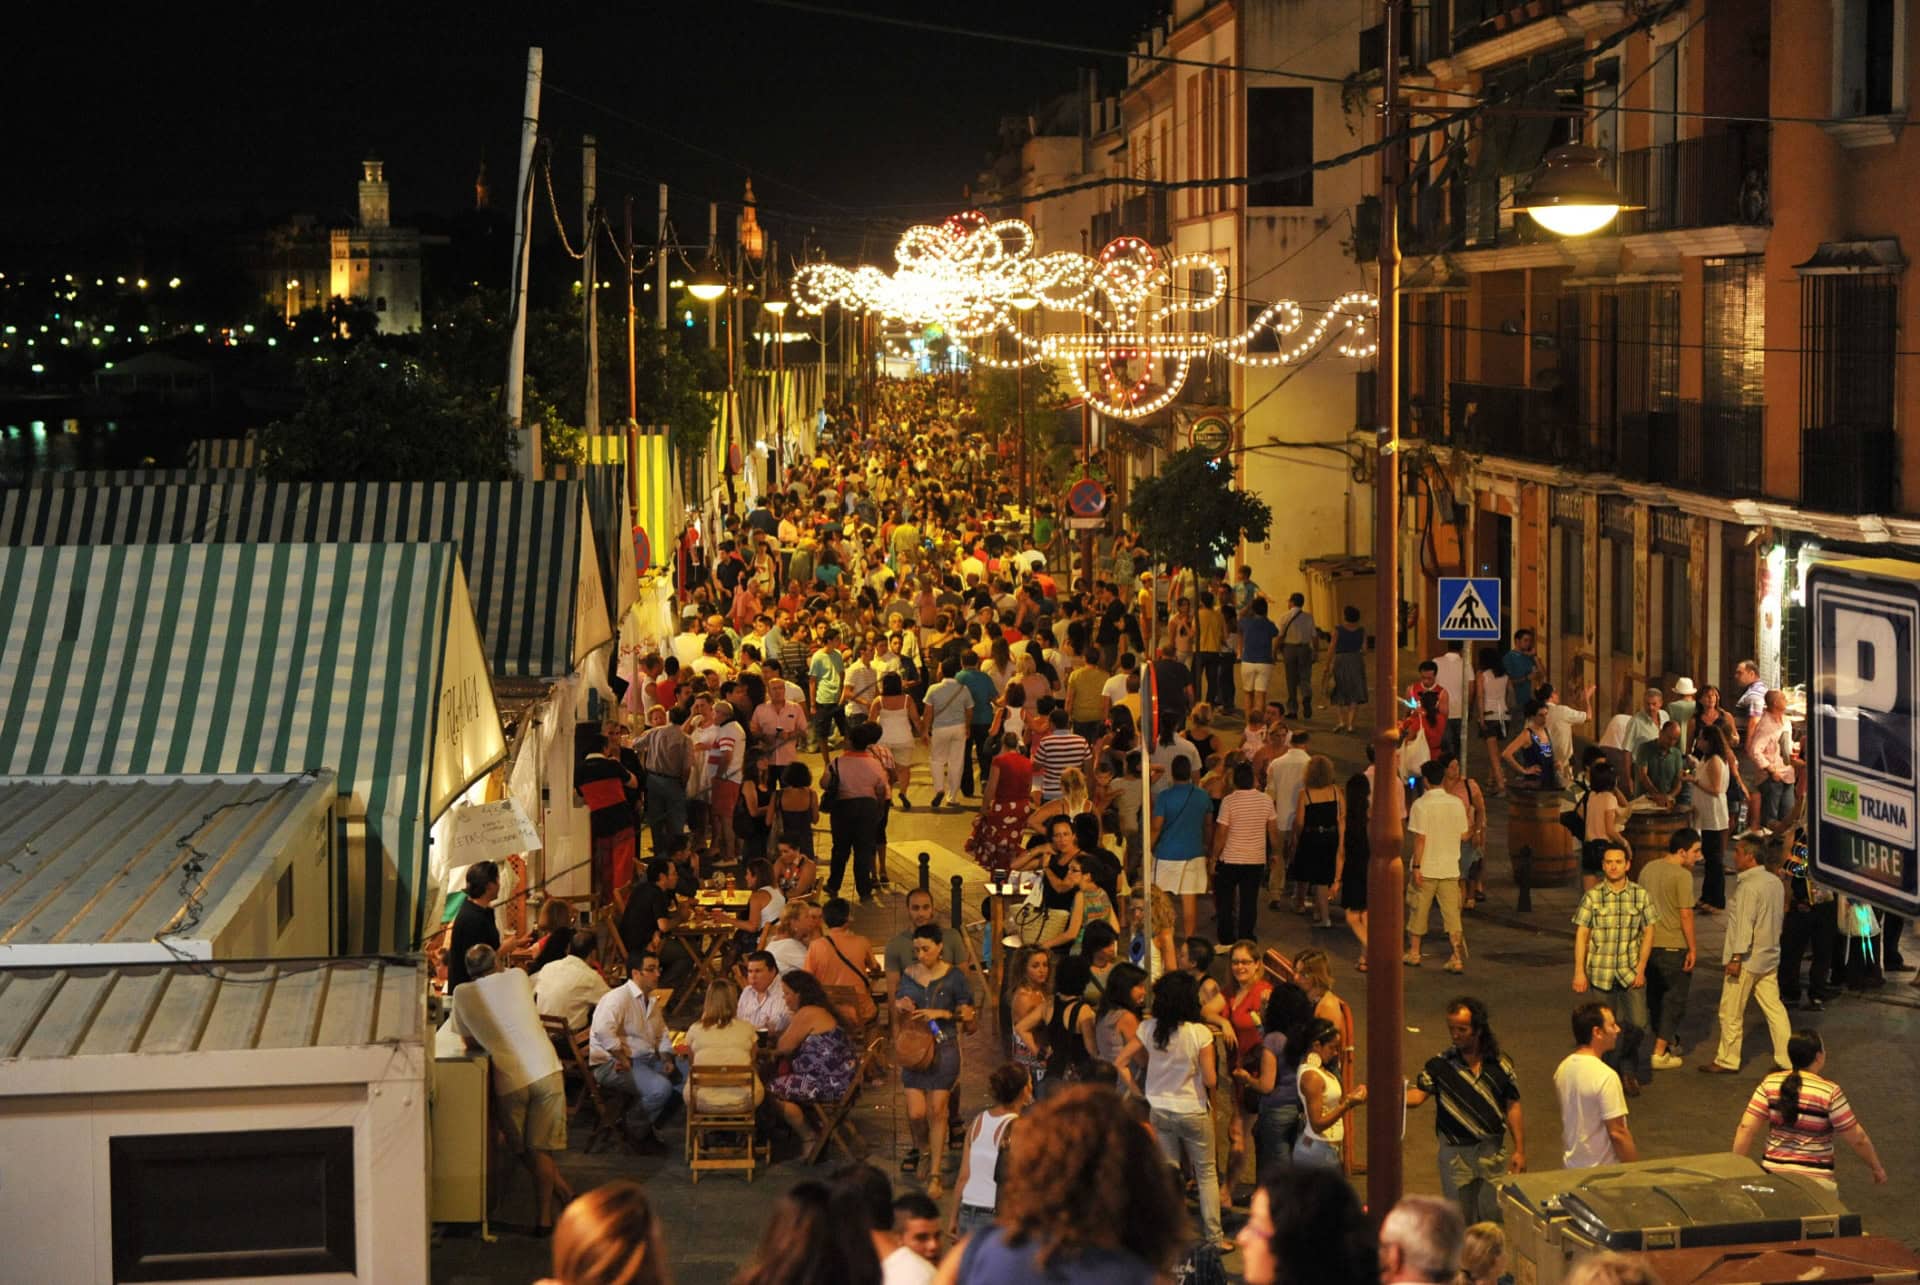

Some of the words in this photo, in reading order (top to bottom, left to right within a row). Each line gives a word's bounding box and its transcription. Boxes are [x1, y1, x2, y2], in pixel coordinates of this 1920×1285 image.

[1835, 608, 1898, 762] P
[1859, 794, 1907, 829] TRIANA
[1851, 836, 1901, 877] LIBRE
